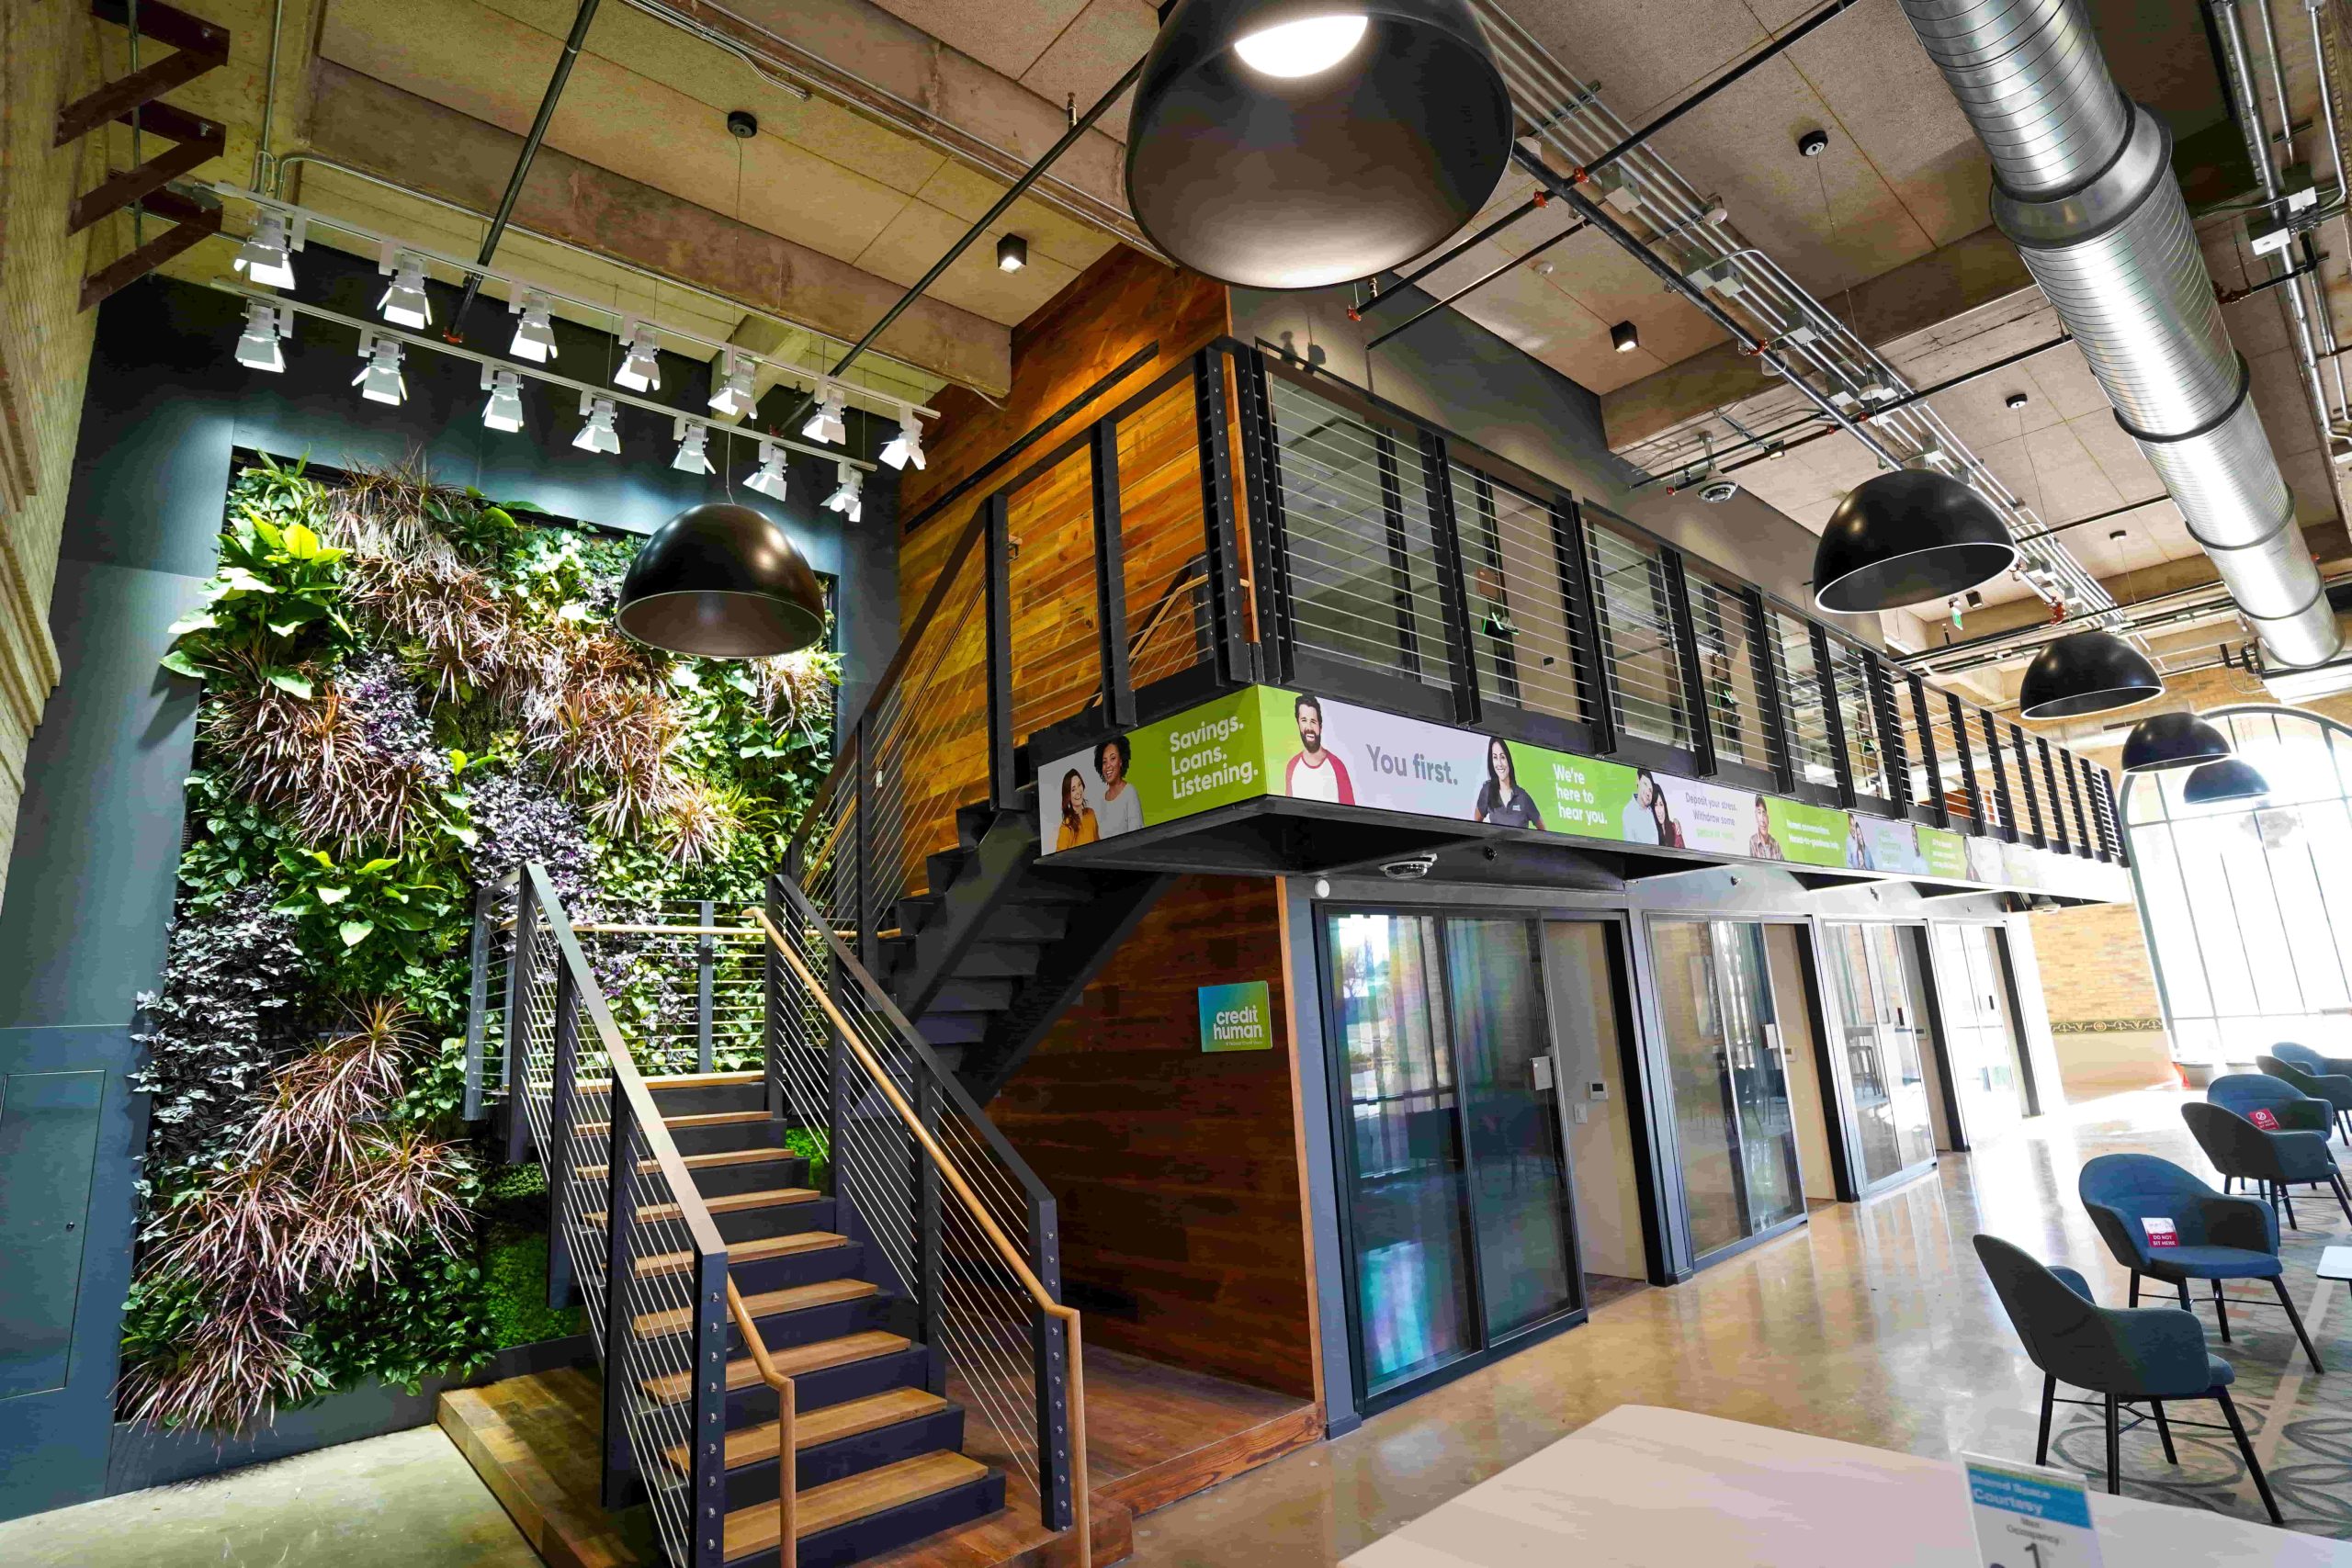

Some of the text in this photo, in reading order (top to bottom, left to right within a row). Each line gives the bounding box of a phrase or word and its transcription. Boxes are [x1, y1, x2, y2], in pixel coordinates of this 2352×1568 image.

[1169, 716, 1245, 752] Savings.
[1170, 746, 1228, 776] Loans.
[1365, 743, 1459, 786] You first.
[1552, 762, 1586, 785] We're
[1172, 761, 1259, 800] Listening.
[1555, 782, 1594, 805] here to
[1685, 792, 1708, 807] Deposit
[1557, 801, 1609, 826] hear you.
[1216, 1004, 1259, 1026] credit
[1213, 1022, 1263, 1041] human
[2024, 1542, 2041, 1568] 1
